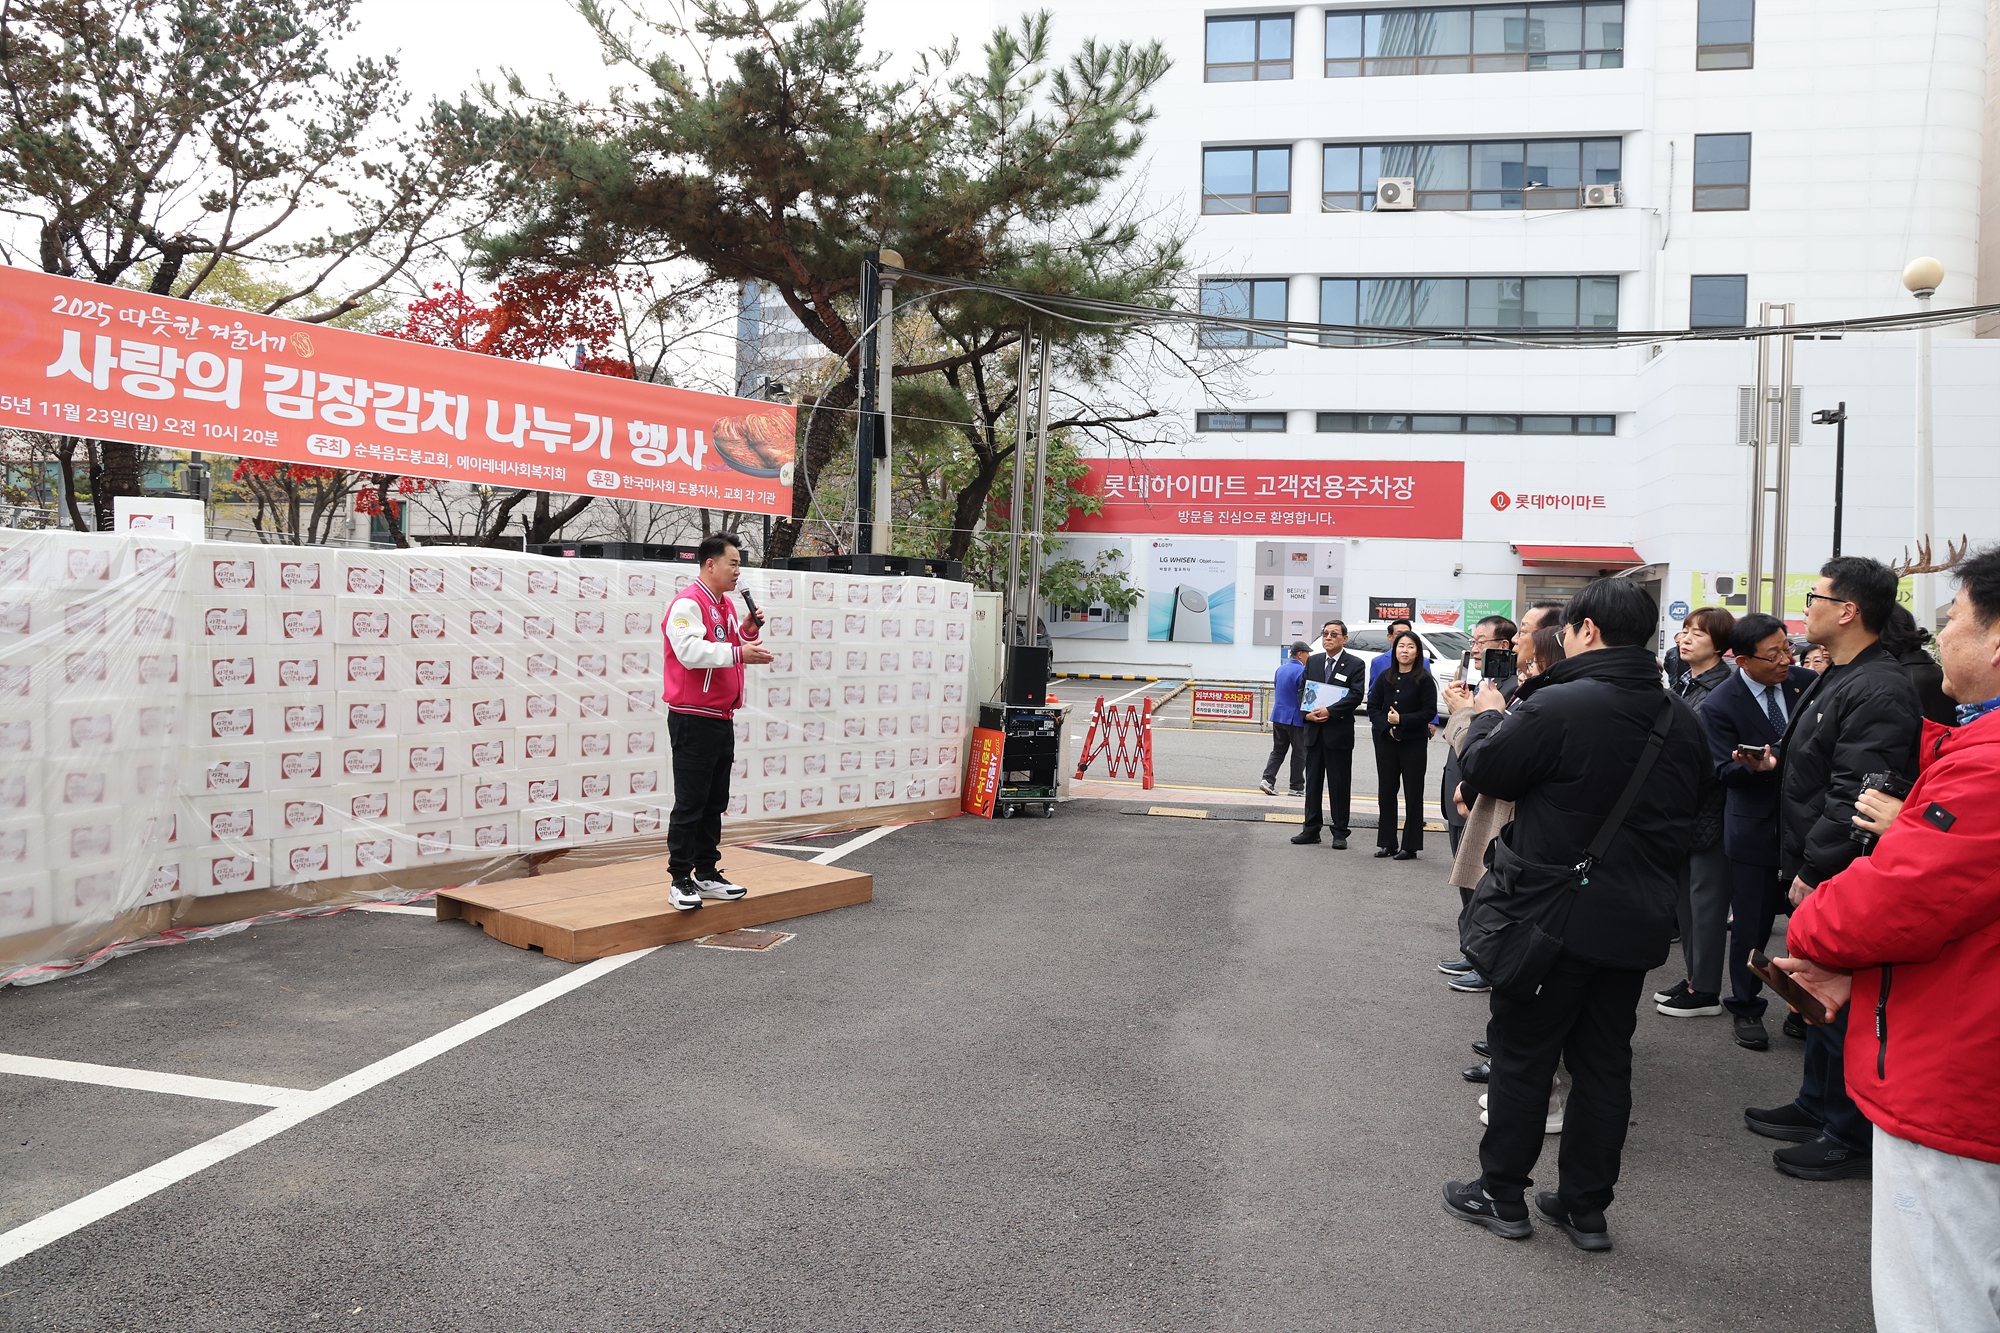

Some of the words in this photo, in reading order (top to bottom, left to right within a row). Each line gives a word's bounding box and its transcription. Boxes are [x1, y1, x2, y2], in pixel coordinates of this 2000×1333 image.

[52, 295, 115, 328] 2025
[119, 306, 204, 341] 따뜻한
[208, 320, 287, 353] 겨울나기
[46, 329, 244, 410] 사랑의
[263, 363, 470, 441] 김장김치
[485, 398, 614, 460] 나누기
[627, 419, 709, 471] 행사
[39, 400, 81, 423] 11월
[86, 407, 158, 432] 23일(일)
[162, 417, 196, 438] 오전
[202, 423, 238, 443] 10시
[242, 428, 279, 447] 20분
[313, 437, 344, 456] 주최
[353, 441, 453, 470] 순복음도봉교회,
[456, 455, 567, 482] 에이레네사회복지회
[592, 471, 615, 487] 후원
[622, 474, 675, 495] 한국마사회
[677, 480, 721, 500] 도봉지사,
[723, 486, 743, 503] 교회
[745, 488, 755, 504] 각
[757, 491, 776, 506] 기관
[1103, 474, 1248, 500] 롯데하이마트
[1254, 474, 1416, 501] 고객전용주차장
[1515, 493, 1607, 511] 롯데하이마트
[1177, 510, 1216, 525] 방문을
[1217, 510, 1267, 525] 진심으로
[1269, 510, 1336, 526] 환영합니다.
[1196, 692, 1222, 700] 외부차량
[1224, 693, 1250, 701] 주차금지
[981, 739, 992, 766] 김장
[973, 767, 988, 807] 나누기
[985, 753, 998, 794] 사랑의
